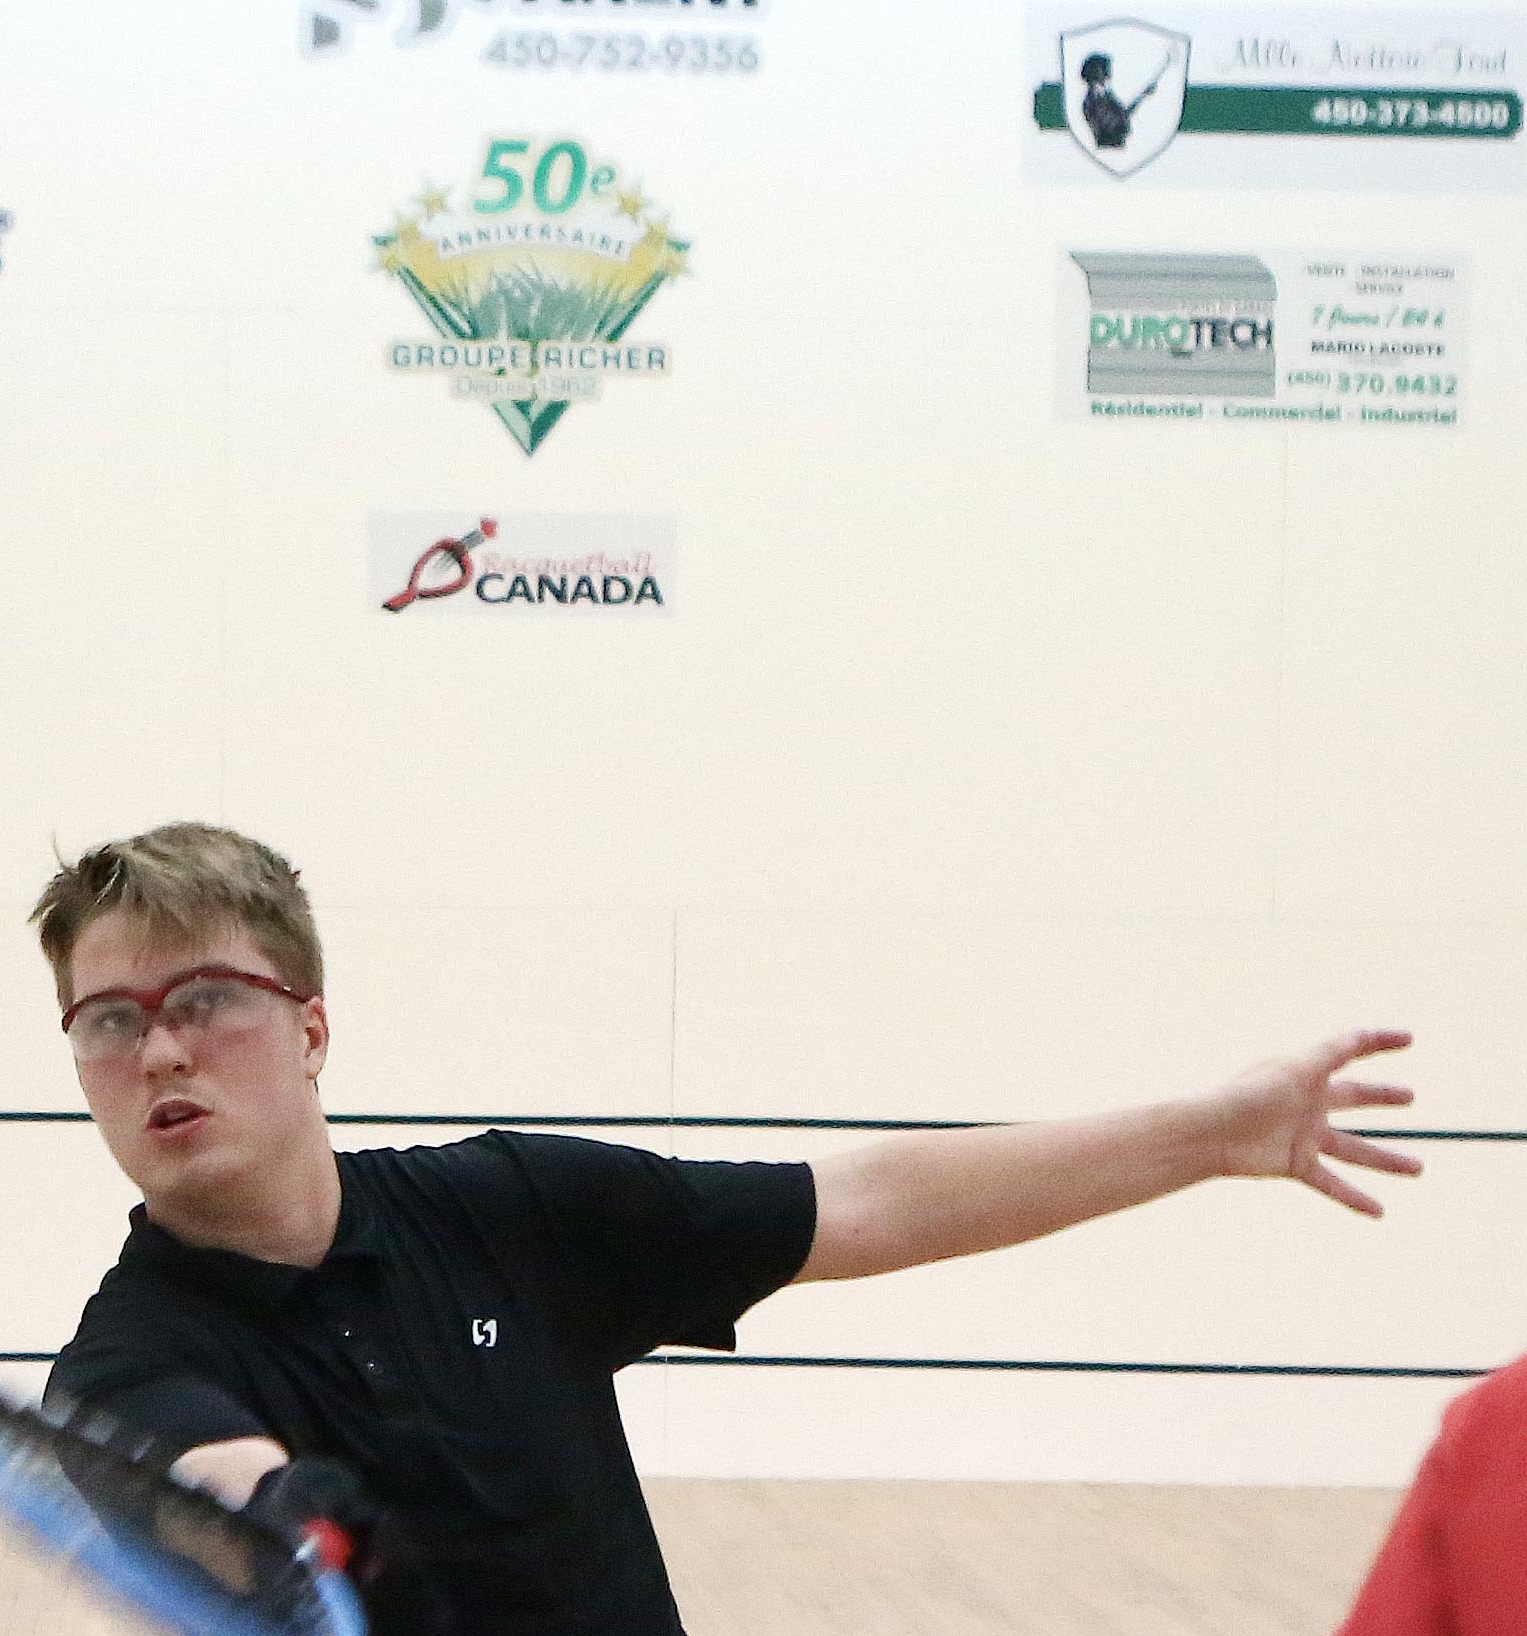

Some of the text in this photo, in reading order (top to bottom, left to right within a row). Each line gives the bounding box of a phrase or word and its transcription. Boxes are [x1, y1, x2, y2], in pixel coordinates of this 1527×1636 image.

[1090, 315, 1273, 350] DUROTECH
[544, 346, 667, 371] RICHER
[476, 573, 664, 605] CANADA
